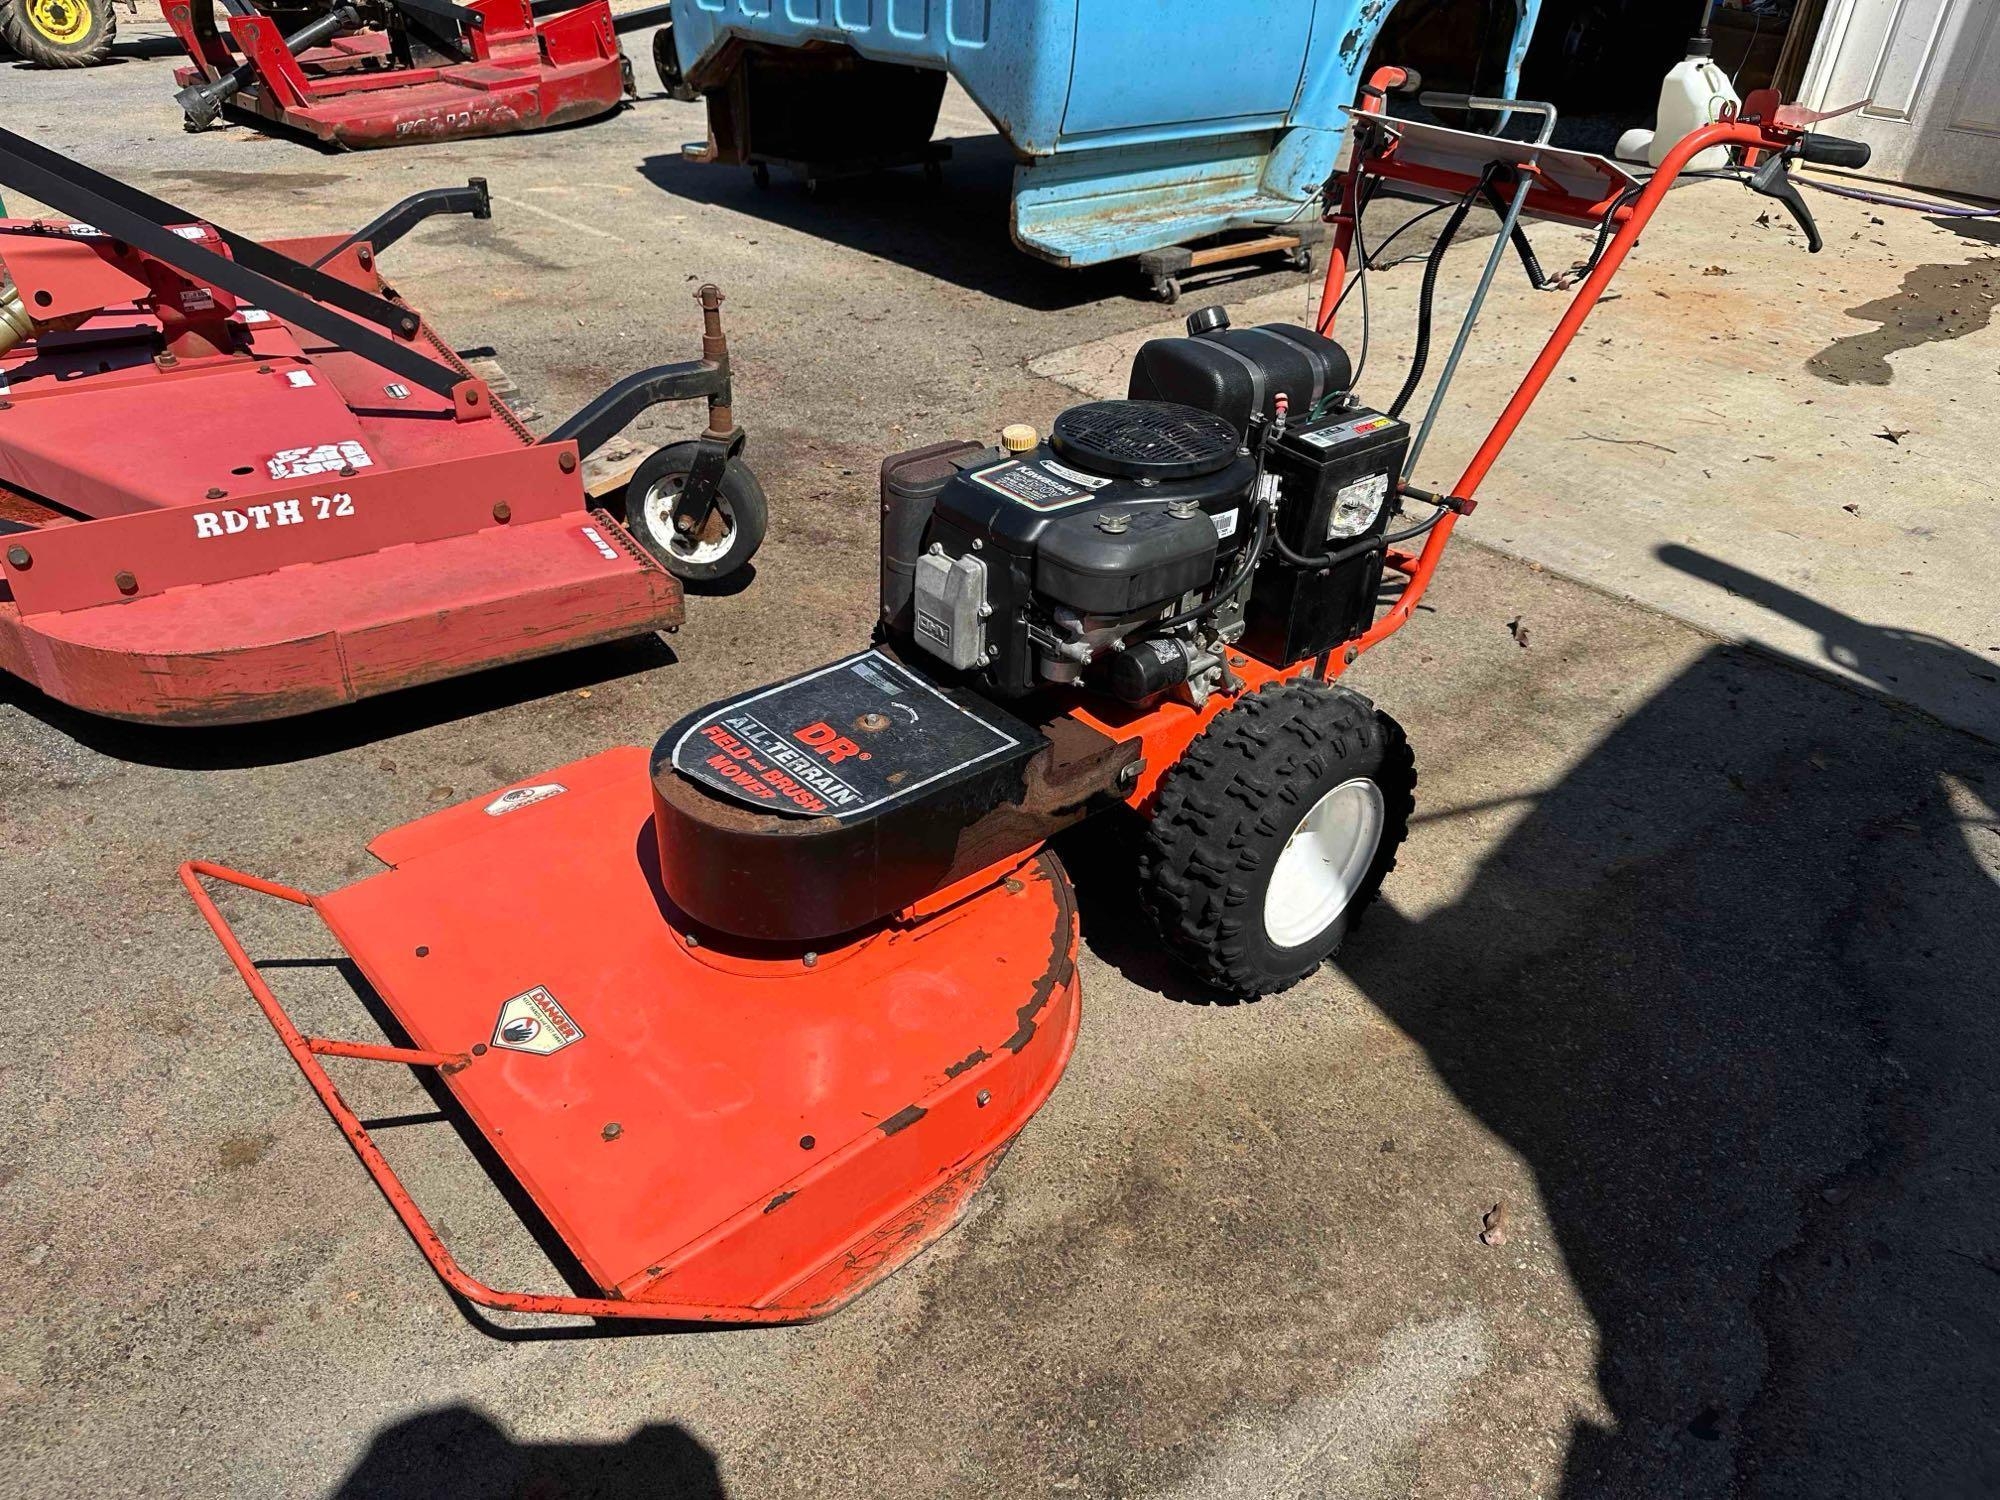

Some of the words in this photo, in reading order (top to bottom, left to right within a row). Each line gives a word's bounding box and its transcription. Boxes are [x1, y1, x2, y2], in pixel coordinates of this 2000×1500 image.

[1015, 465, 1079, 496] Kawasaki
[193, 499, 304, 538] RDTH
[311, 493, 355, 520] 72
[701, 725, 755, 761] FIELD
[748, 757, 768, 772] and
[761, 769, 829, 813] BRUSH
[706, 754, 778, 801] MOWER
[532, 991, 576, 1039] DANGER
